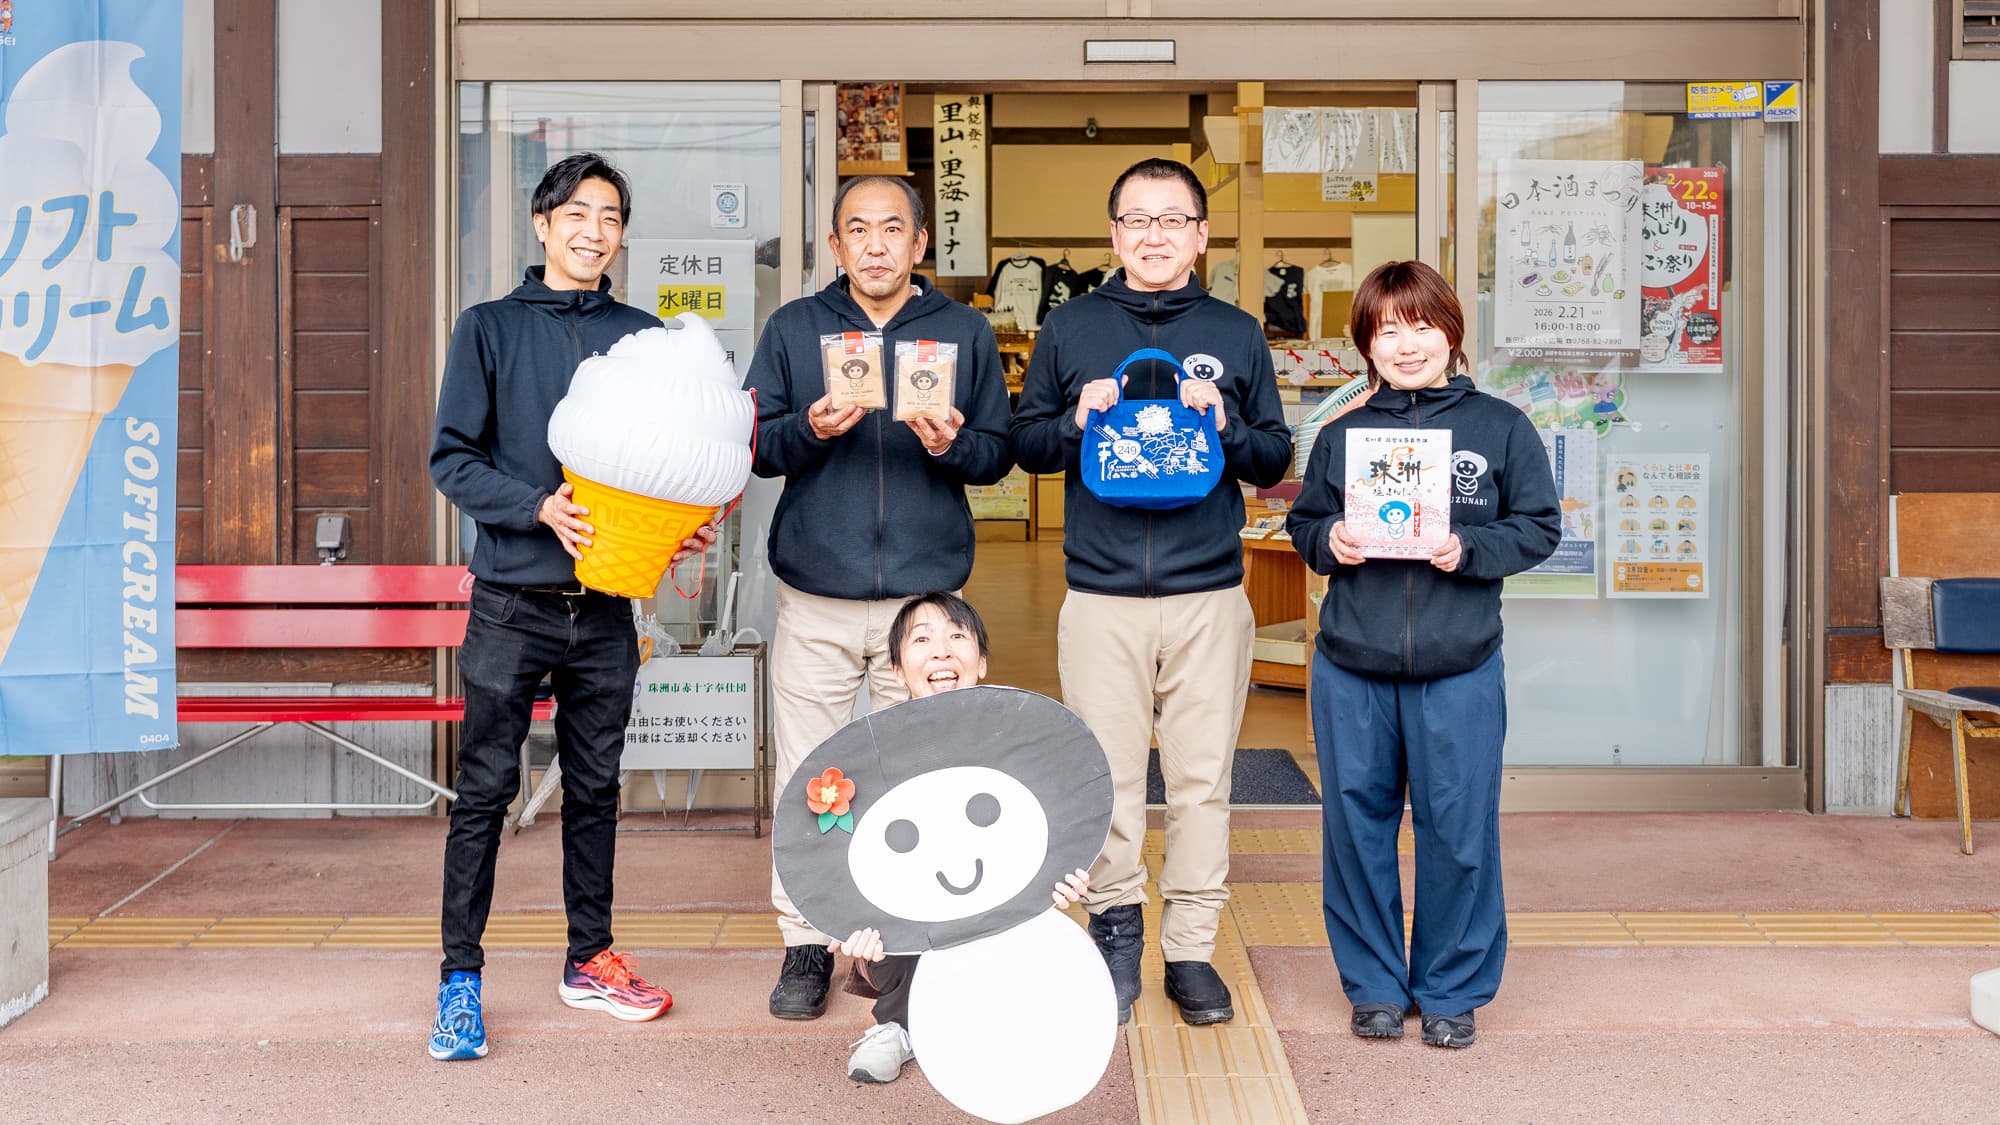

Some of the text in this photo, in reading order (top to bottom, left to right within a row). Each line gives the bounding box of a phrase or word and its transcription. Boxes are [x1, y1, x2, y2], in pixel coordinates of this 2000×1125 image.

[1766, 108, 1796, 116] ALSOK
[938, 101, 970, 271] 里山・里海コーナー
[1501, 174, 1639, 213] 日本酒まつり
[659, 254, 722, 275] 定休日
[1641, 254, 1693, 273] こう祭り
[659, 289, 721, 310] 水曜日
[0, 266, 170, 362] リーム
[1533, 308, 1553, 317] 2026
[1558, 306, 1585, 319] 2.21
[1535, 322, 1601, 331] 16:00-18:00
[1117, 445, 1137, 455] 249
[1369, 459, 1422, 486] 珠洲
[1643, 472, 1701, 480] なんでも相談会
[593, 501, 687, 539] NISSEI
[648, 682, 747, 693] 珠洲市赤十字奉仕団
[140, 734, 170, 744] D404
[626, 732, 747, 743] 用後はご返却ください
